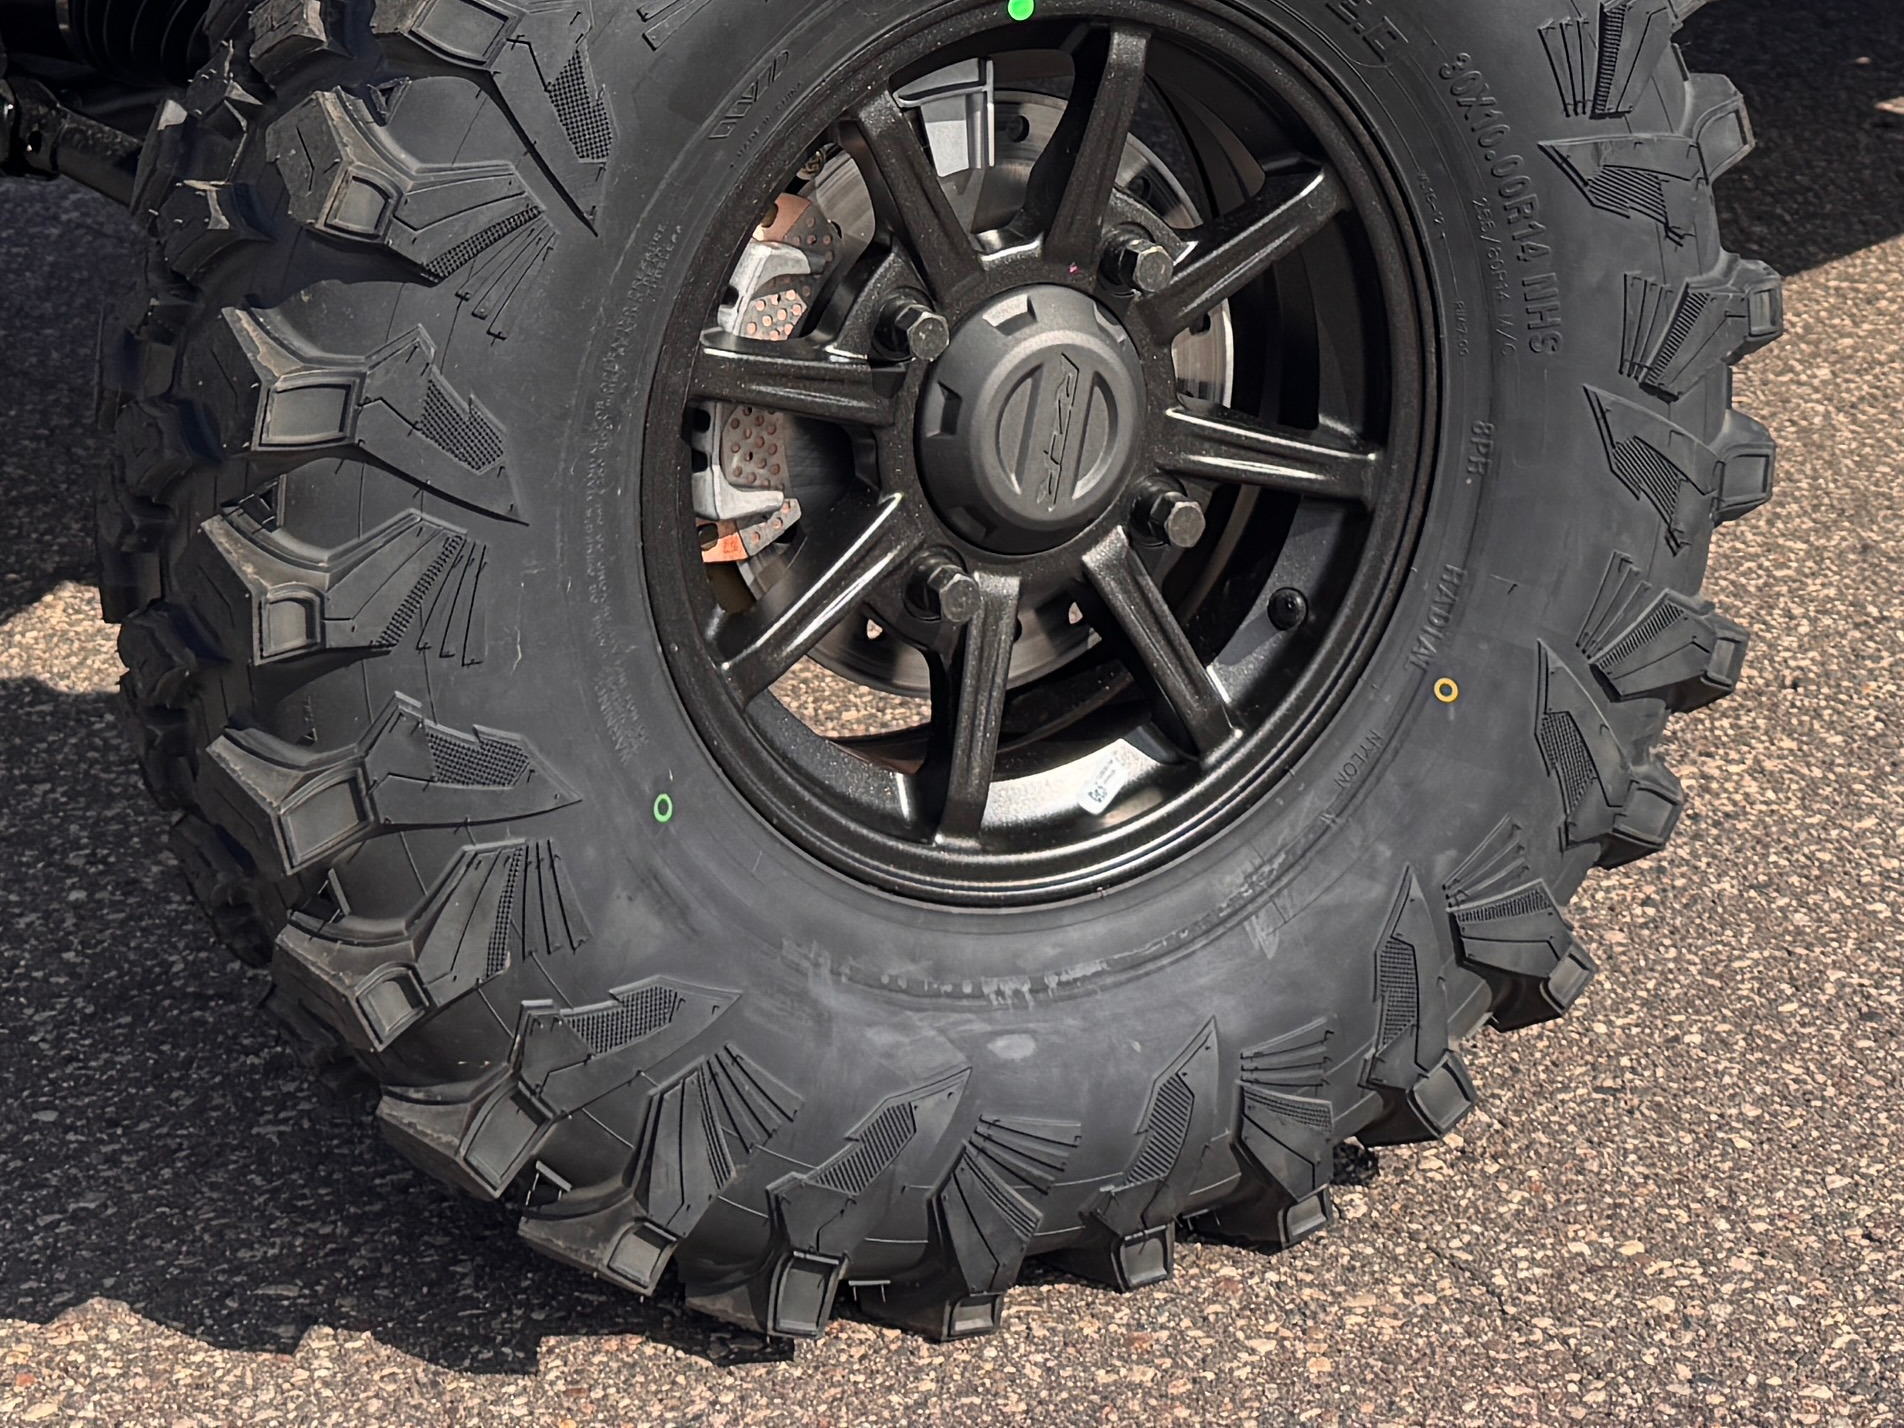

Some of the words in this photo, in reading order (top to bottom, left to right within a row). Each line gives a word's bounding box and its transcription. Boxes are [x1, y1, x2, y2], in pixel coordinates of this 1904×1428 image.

[1438, 52, 1552, 263] 30X10.00R14
[1521, 272, 1563, 355] NHS
[1037, 351, 1081, 513] RZR
[1404, 564, 1467, 673] RADIAL
[1333, 729, 1385, 791] NYLON
